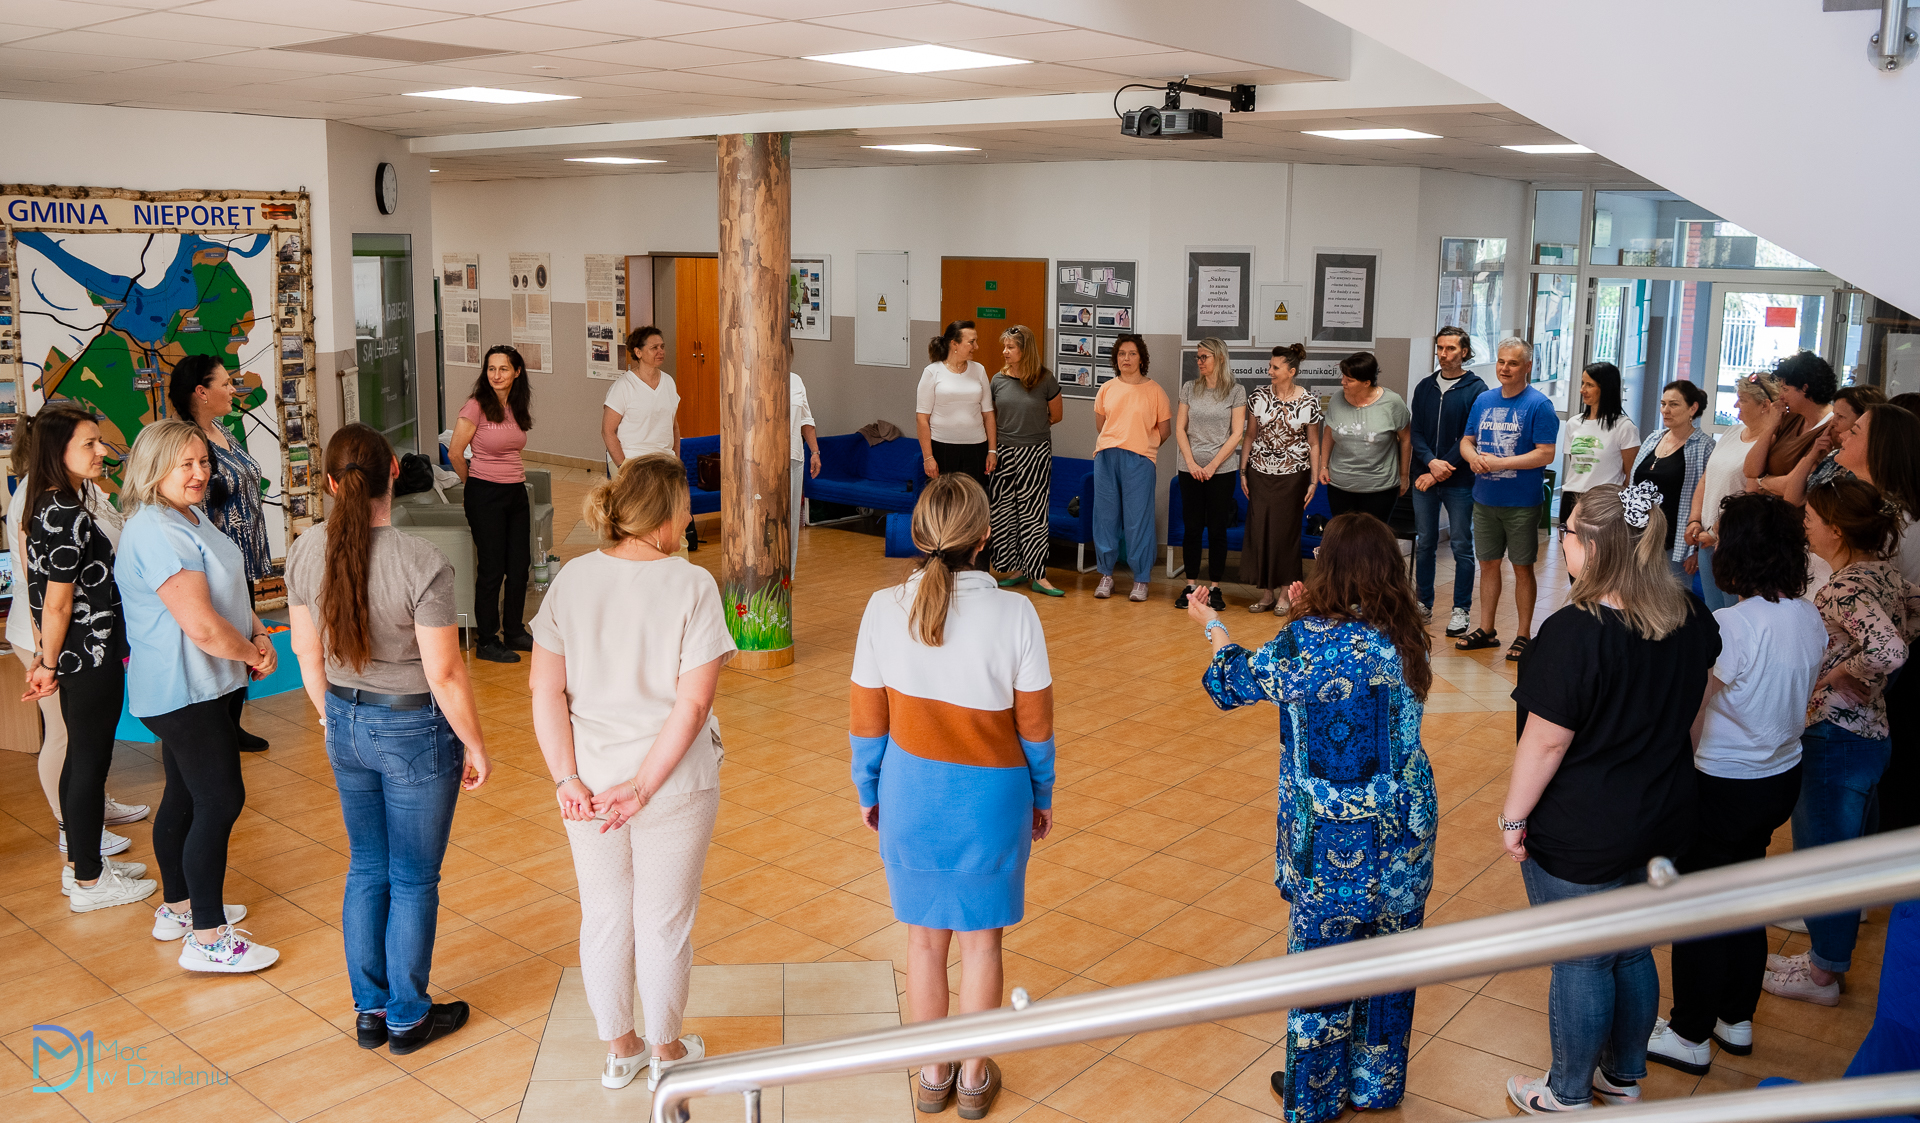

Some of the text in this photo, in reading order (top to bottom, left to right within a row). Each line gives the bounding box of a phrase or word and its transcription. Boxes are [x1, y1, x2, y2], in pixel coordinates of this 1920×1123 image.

[8, 199, 255, 230] GMINA NIEPORĘT
[1231, 367, 1253, 375] zasad
[1298, 368, 1337, 376] omunikacji
[1480, 422, 1519, 431] EXPLORATION
